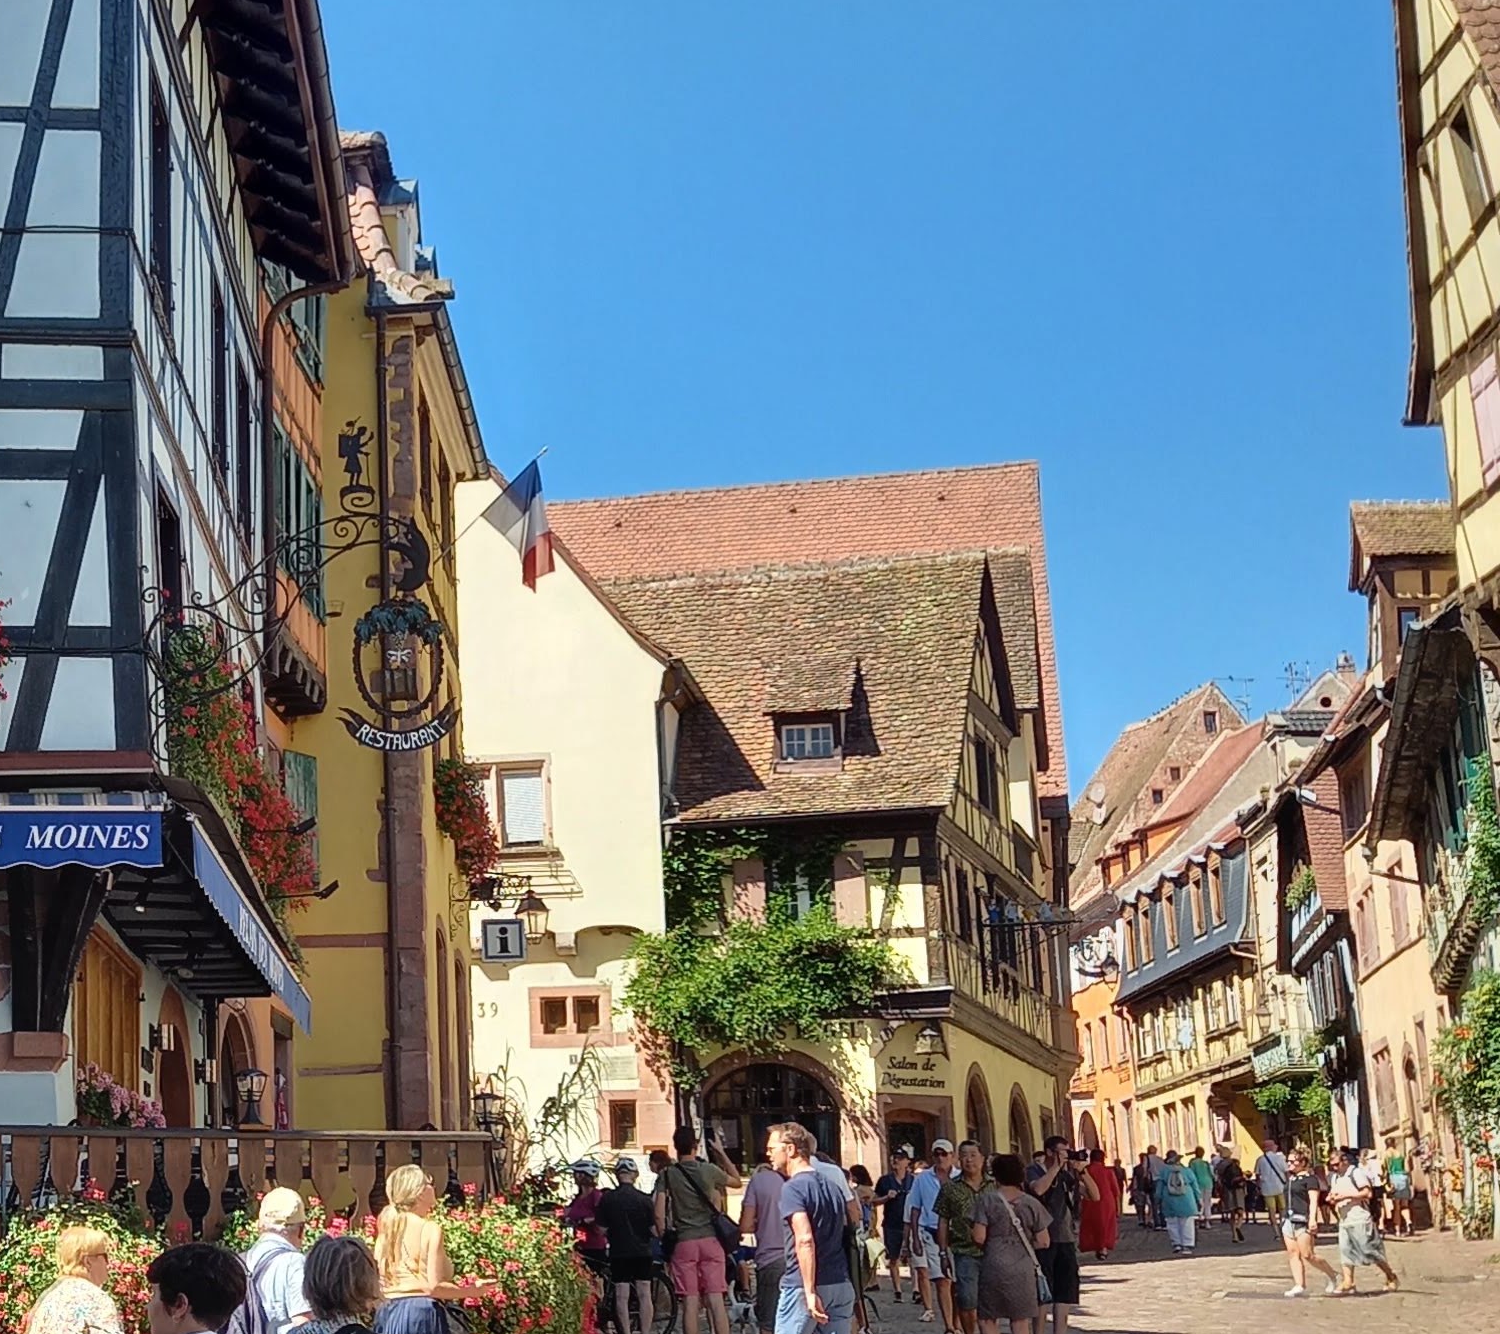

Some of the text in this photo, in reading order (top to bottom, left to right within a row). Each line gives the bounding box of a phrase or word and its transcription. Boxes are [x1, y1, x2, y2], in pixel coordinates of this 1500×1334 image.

[355, 719, 446, 750] RESTAURANT
[25, 824, 150, 849] MOINES
[477, 1002, 498, 1018] 39
[887, 1056, 936, 1071] Salon de
[881, 1072, 945, 1089] Dégustation
